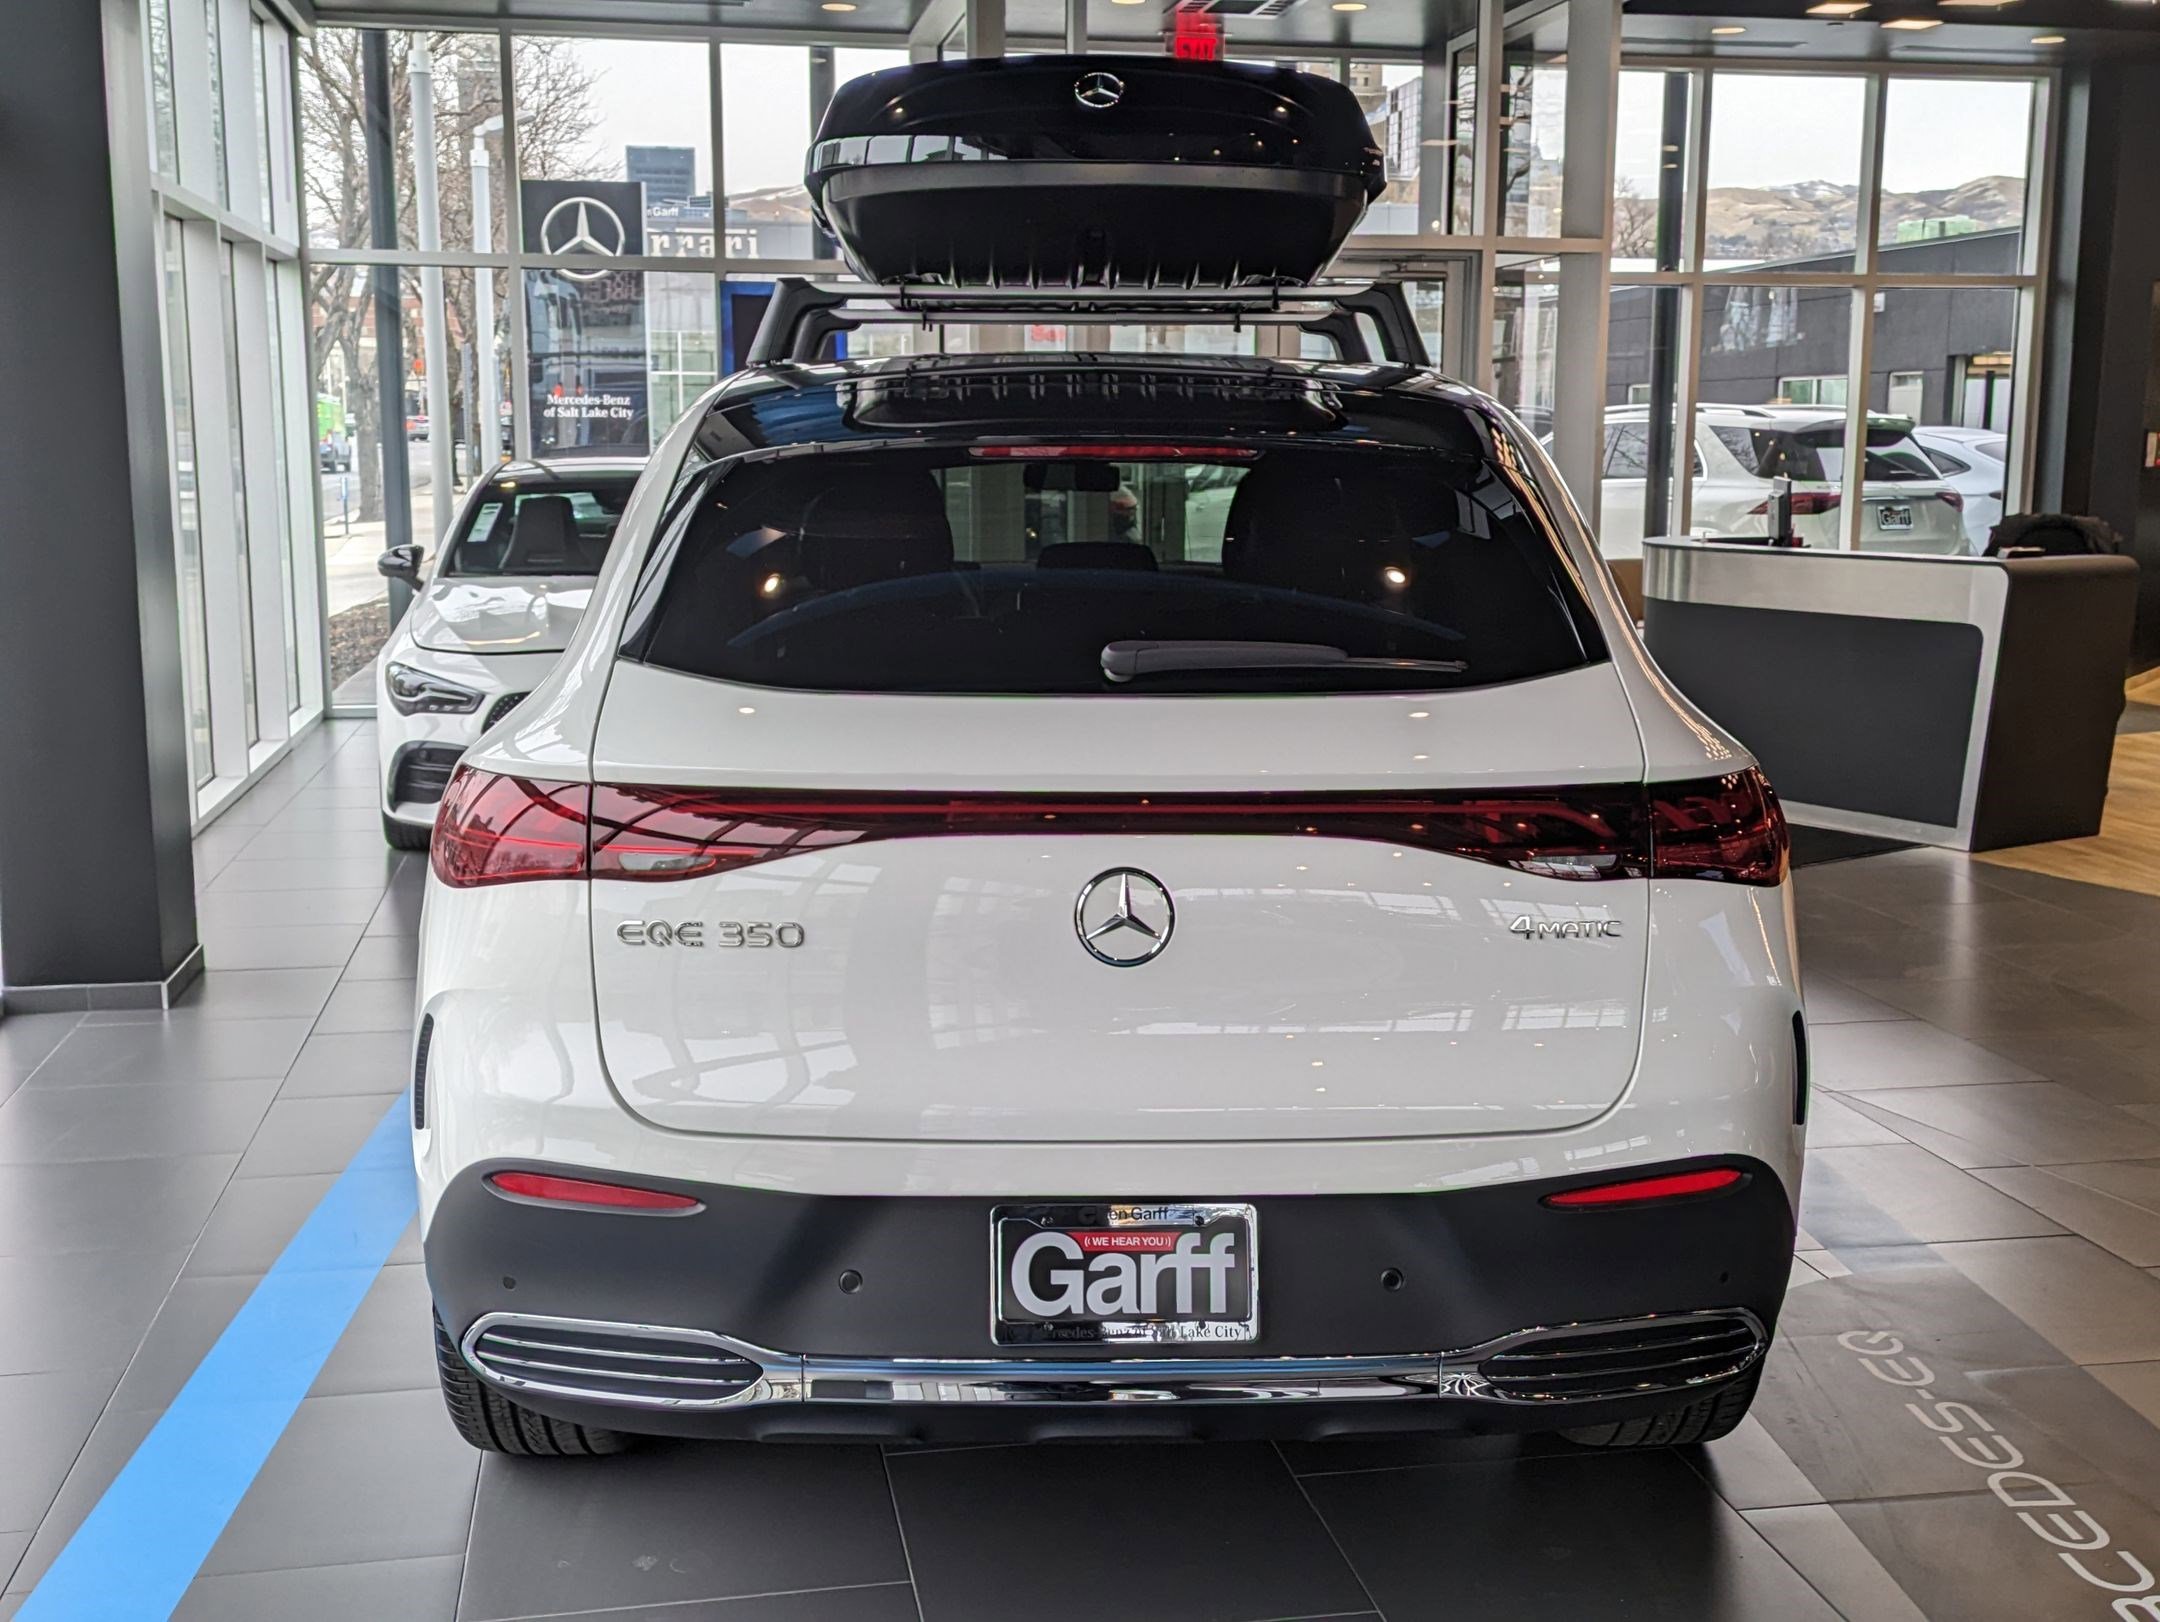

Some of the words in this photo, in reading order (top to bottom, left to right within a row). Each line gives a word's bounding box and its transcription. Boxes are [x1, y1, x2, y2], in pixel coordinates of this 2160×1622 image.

[648, 228, 760, 258] rrari
[546, 394, 631, 406] Mercedes-Benz
[543, 406, 556, 418] of
[557, 407, 580, 418] Salt
[581, 407, 609, 418] Lake
[610, 407, 634, 421] City
[617, 920, 703, 947] EQE
[719, 921, 805, 947] 350
[1509, 914, 1622, 940] 4MATIC
[1131, 1207, 1169, 1220] Garff
[1111, 1237, 1140, 1247] HEAR
[1011, 1231, 1235, 1317] Garff
[1181, 1325, 1211, 1338] Lake
[1215, 1325, 1241, 1341] City
